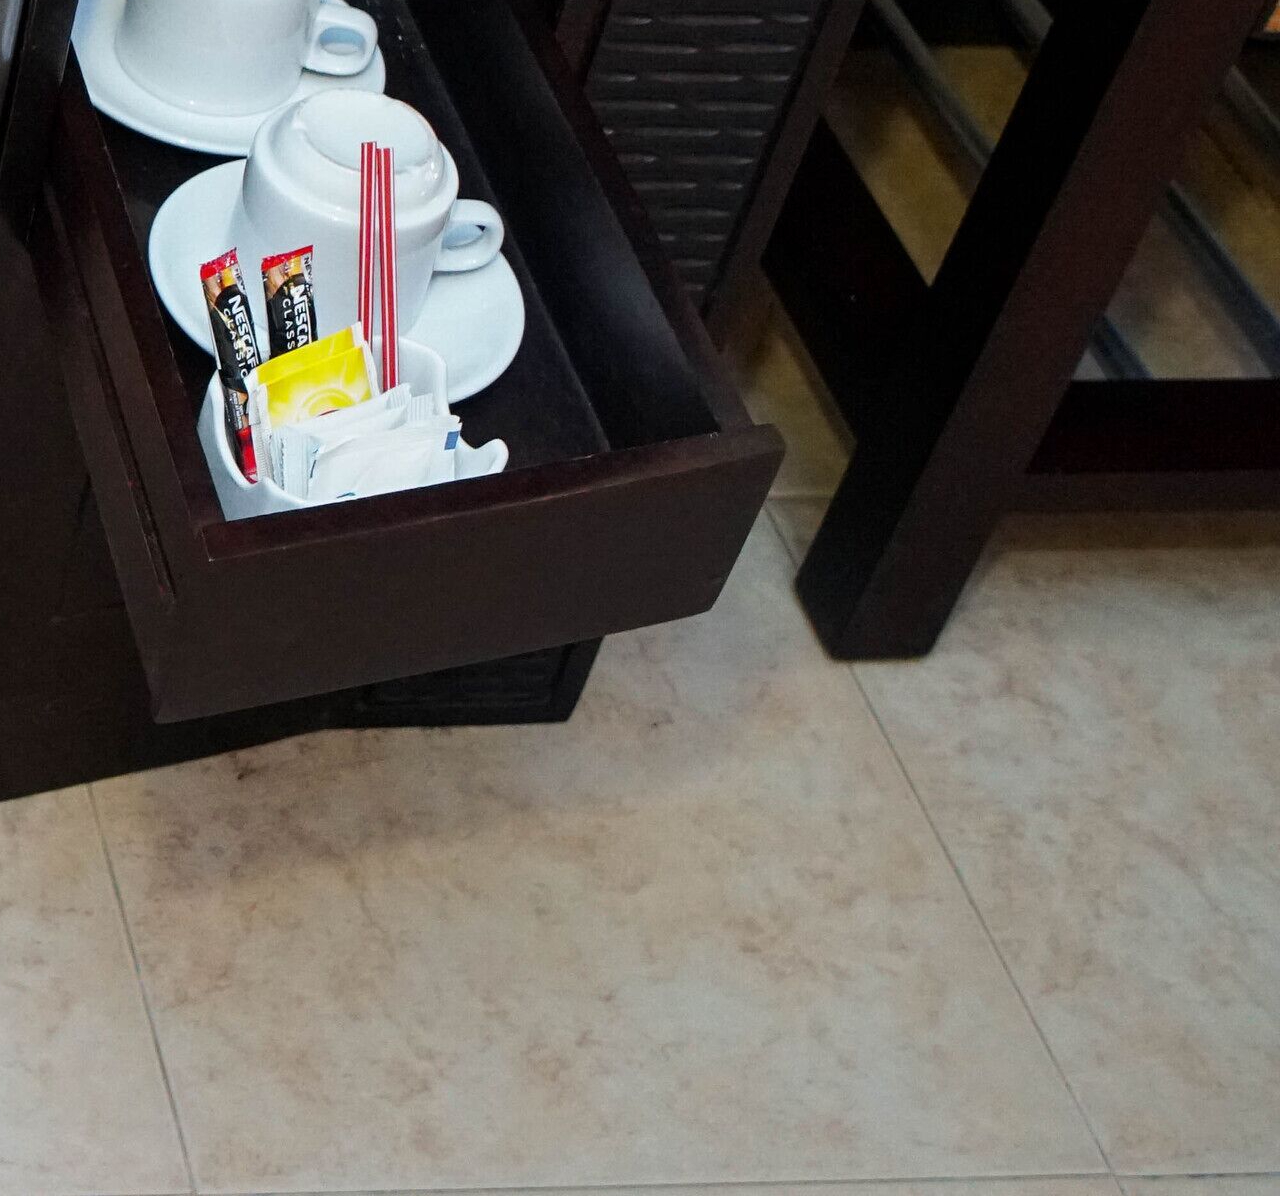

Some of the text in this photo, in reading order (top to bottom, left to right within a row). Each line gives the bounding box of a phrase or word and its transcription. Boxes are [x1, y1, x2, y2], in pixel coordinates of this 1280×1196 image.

[228, 294, 257, 368] NESCAF
[282, 298, 296, 350] CLASS
[290, 284, 309, 348] NESCA
